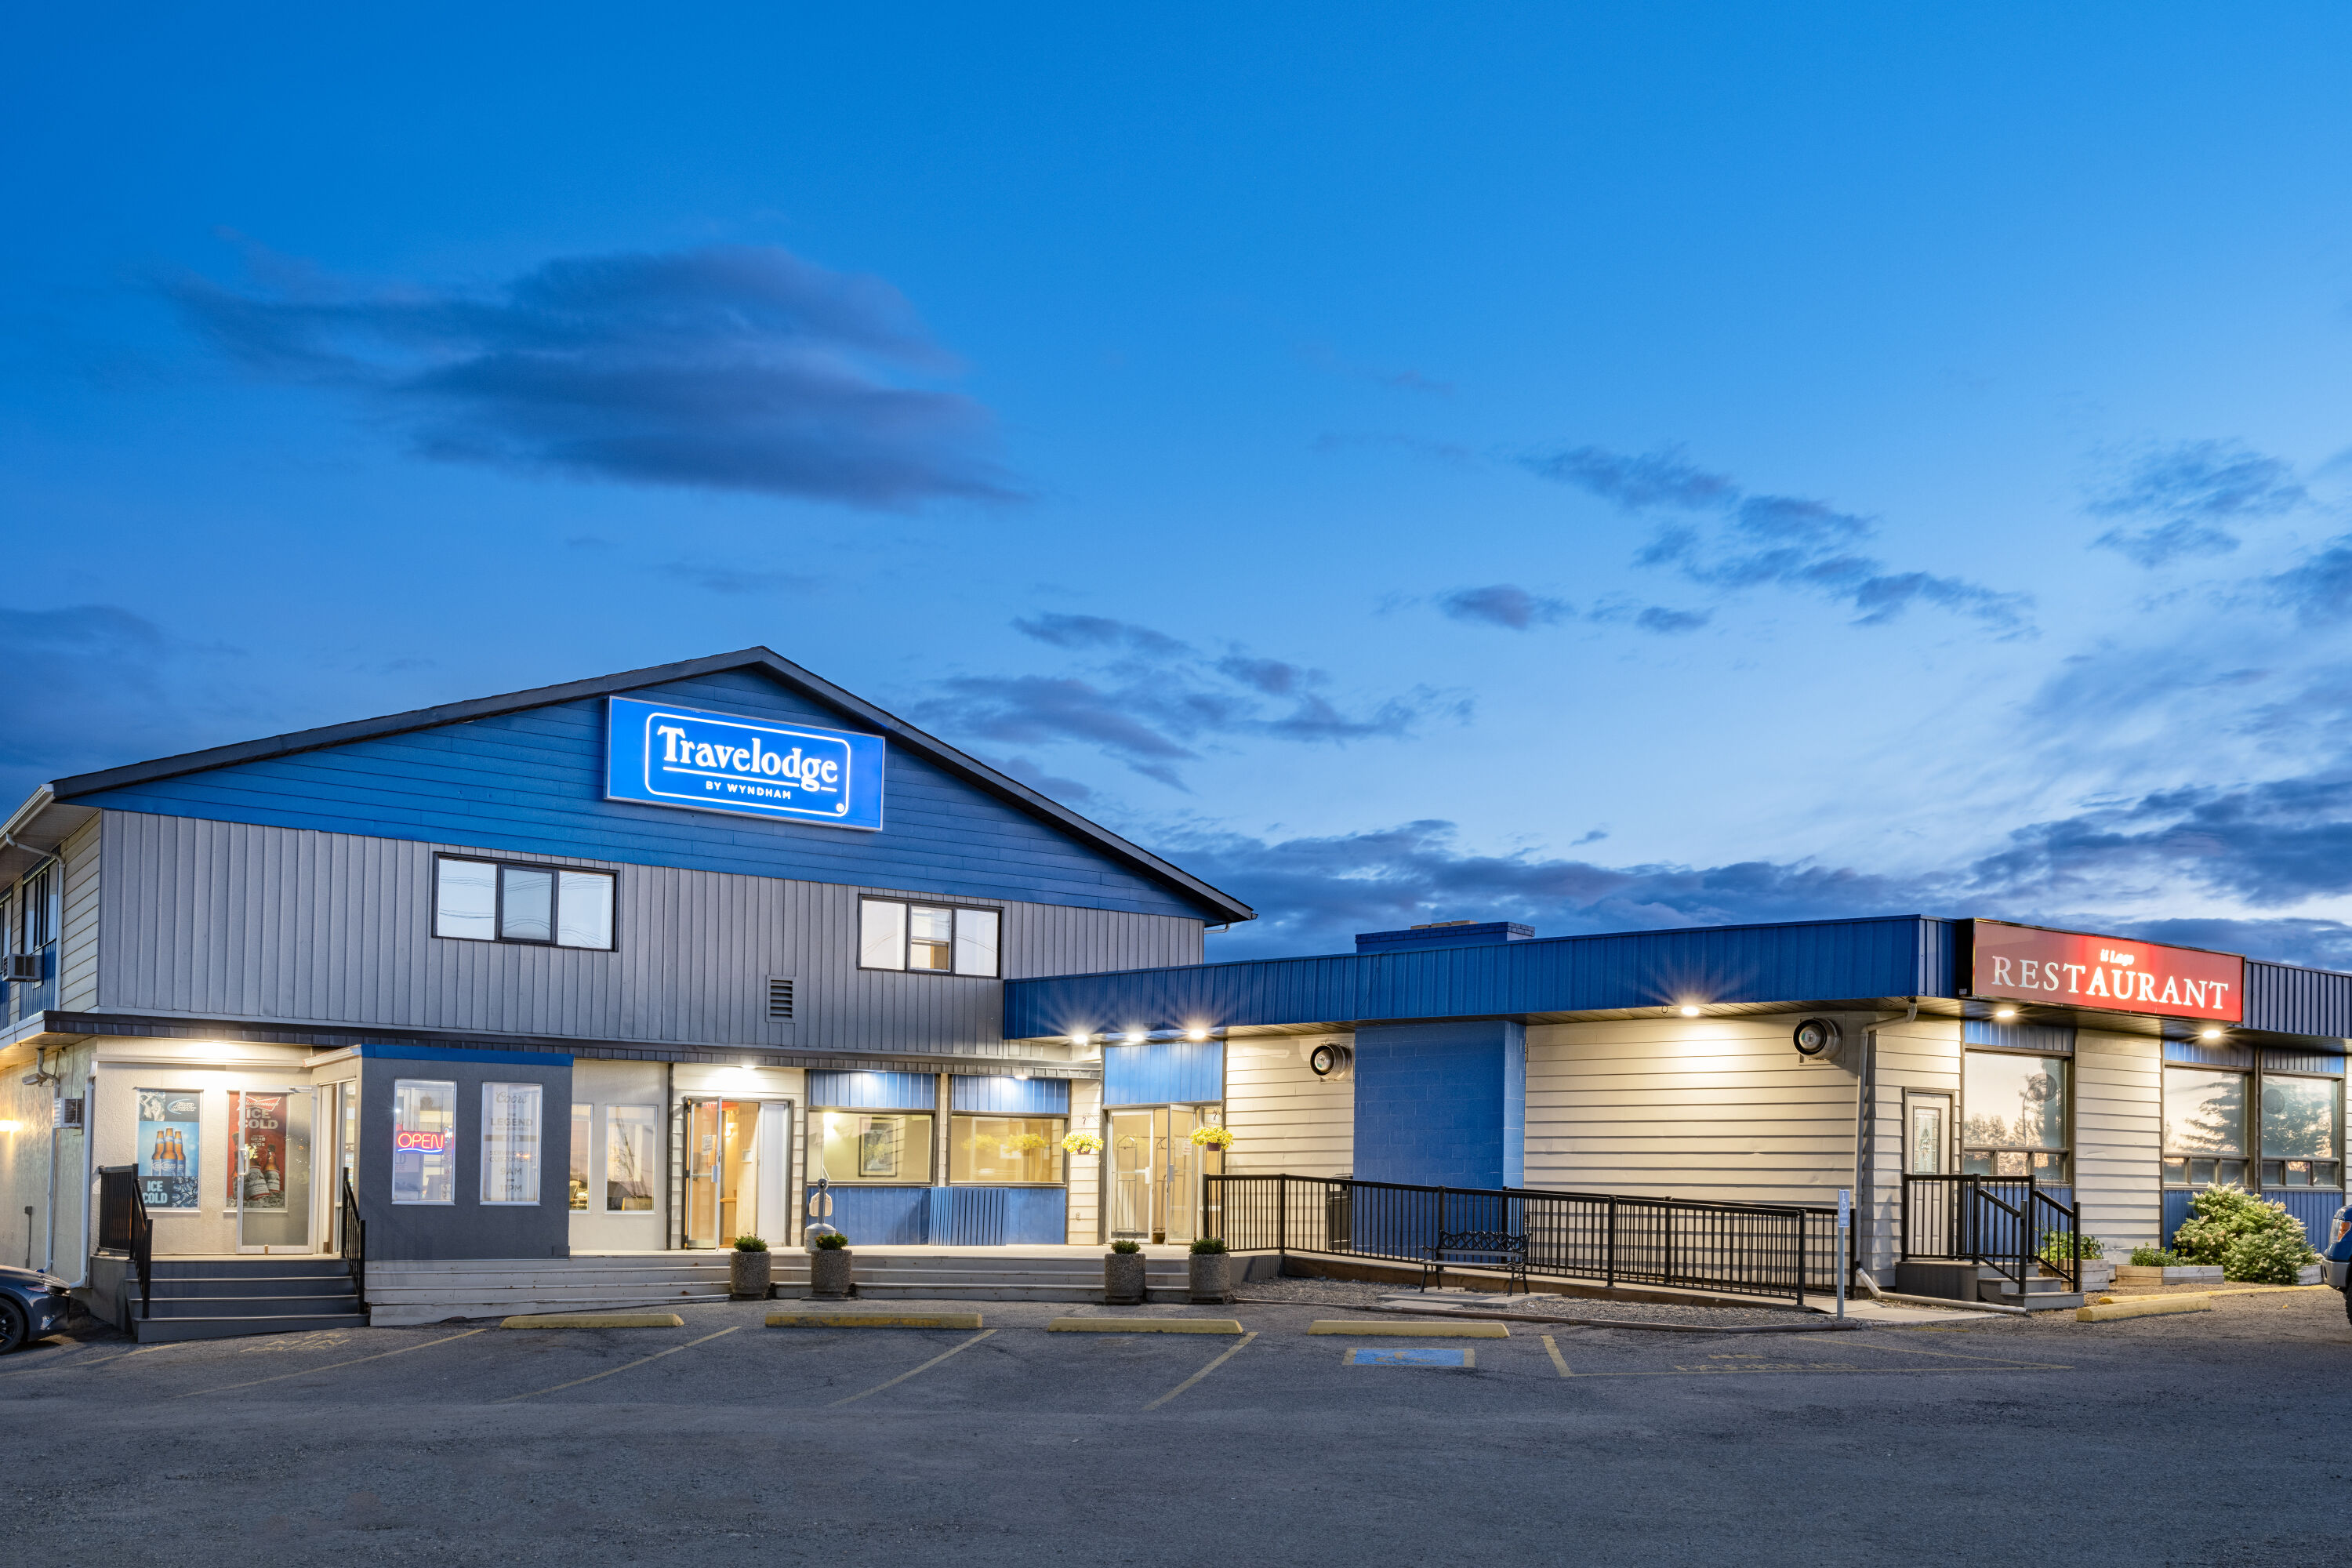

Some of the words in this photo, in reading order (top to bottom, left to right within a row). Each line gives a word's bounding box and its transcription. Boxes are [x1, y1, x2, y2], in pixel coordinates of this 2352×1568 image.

[657, 725, 837, 791] Travelodge
[706, 780, 721, 791] BY
[727, 782, 791, 800] WYNDHAM
[1991, 956, 2228, 1010] RESTAURANT
[246, 1109, 270, 1119] ICE
[491, 1118, 533, 1127] LEGEND
[397, 1133, 444, 1149] OPEN
[500, 1167, 522, 1175] 9AM
[147, 1180, 163, 1192] ICE
[143, 1192, 168, 1204] COLD
